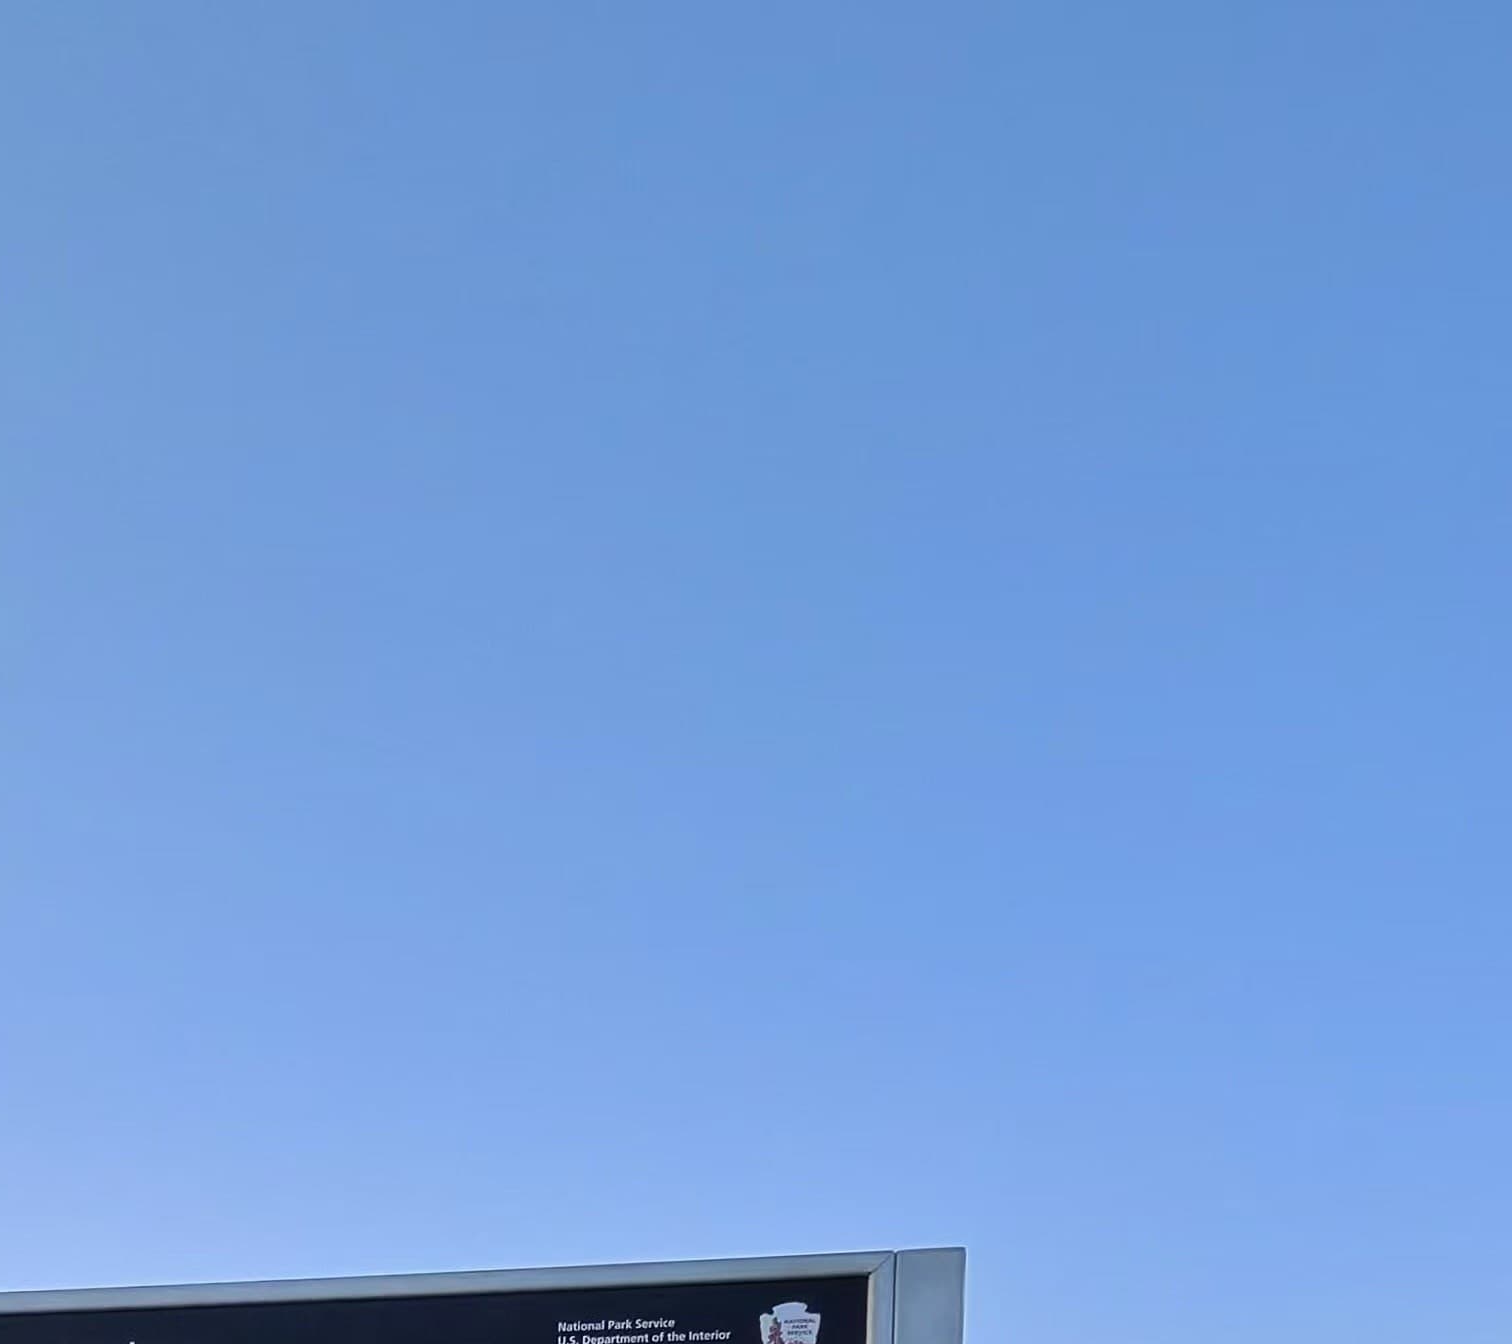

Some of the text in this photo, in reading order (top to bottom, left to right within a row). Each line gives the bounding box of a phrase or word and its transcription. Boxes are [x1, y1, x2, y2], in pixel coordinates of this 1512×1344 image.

[558, 1318, 675, 1332] National Park Service
[651, 1331, 664, 1342] of
[667, 1331, 686, 1341] the
[689, 1329, 730, 1340] Interior
